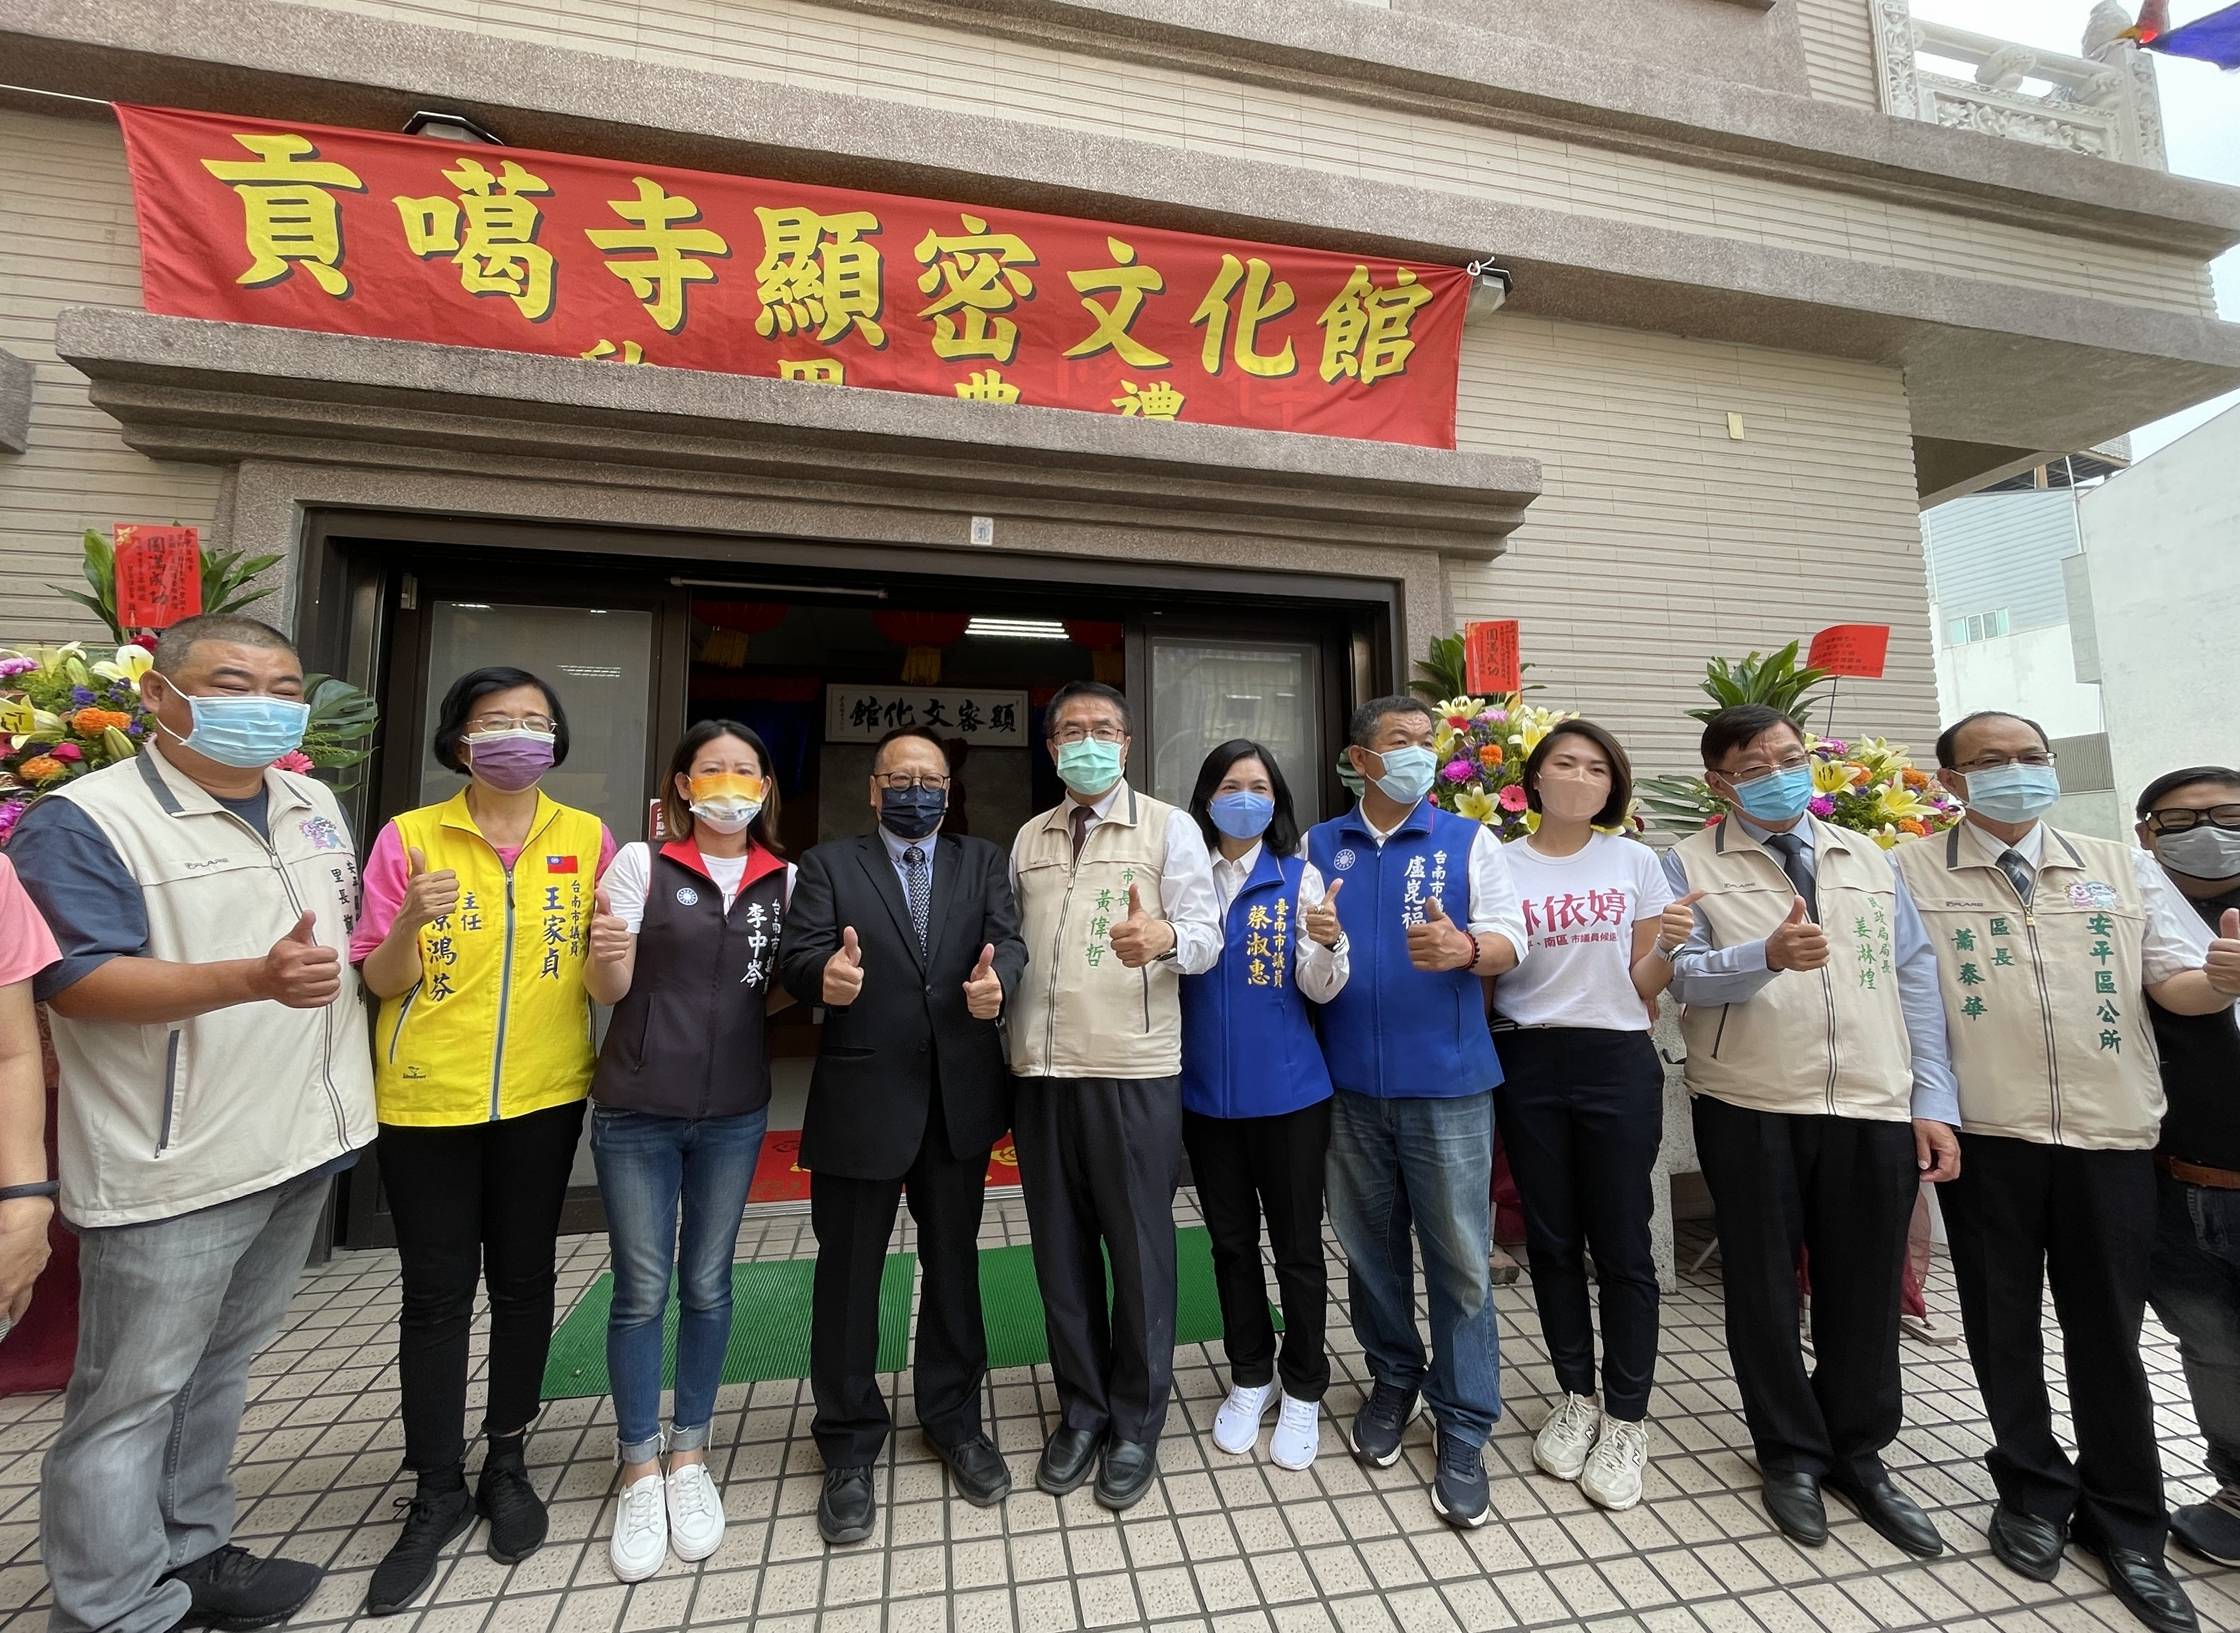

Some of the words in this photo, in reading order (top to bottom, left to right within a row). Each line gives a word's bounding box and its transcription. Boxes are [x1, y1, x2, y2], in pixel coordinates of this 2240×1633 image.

[201, 132, 1435, 386] 貢噶寺顯密文化館
[460, 891, 482, 932] 主任
[540, 885, 568, 980] 王家貞
[740, 902, 769, 988] 李中岑
[1085, 888, 1115, 967] 黃偉哲
[1246, 904, 1273, 986] 蔡淑惠
[1272, 897, 1290, 989] 臺南市議員
[1853, 916, 1877, 990] 姜淋煌
[1989, 917, 2016, 967] 區長
[1951, 928, 1989, 1022] 蕭泰華
[2086, 913, 2122, 1055] 安平區公所
